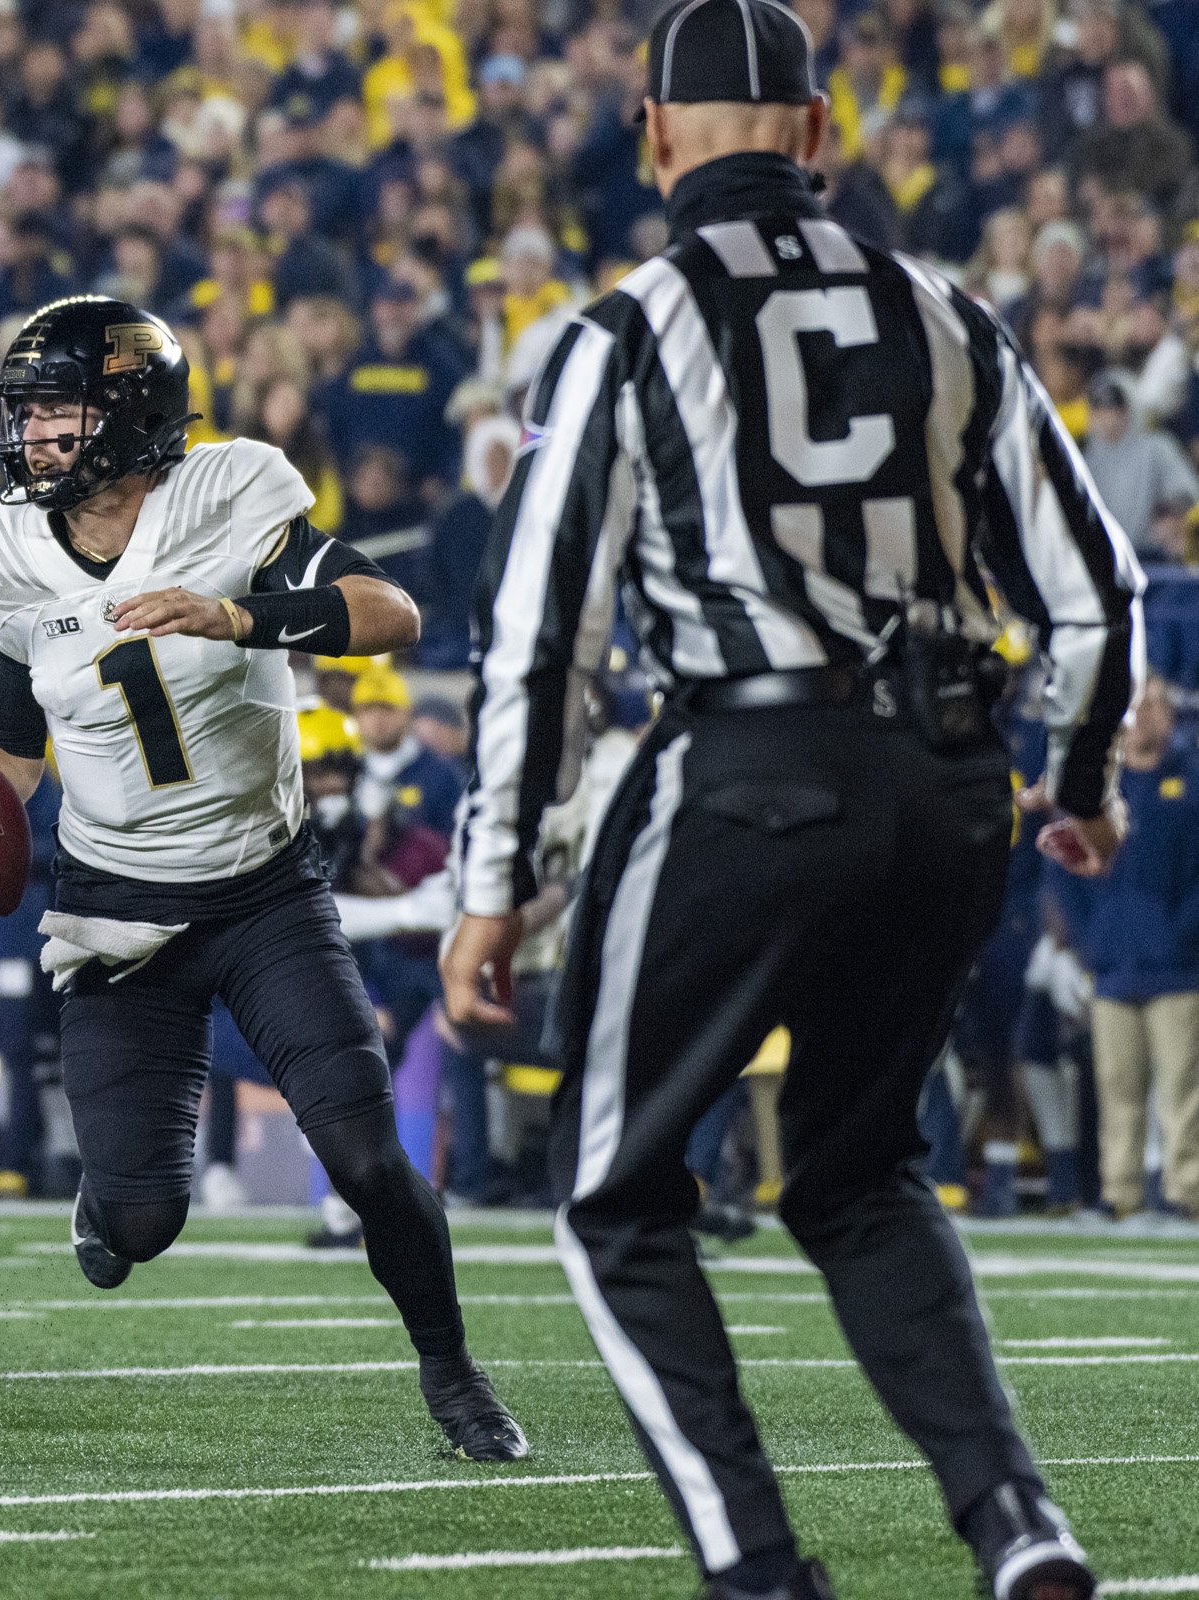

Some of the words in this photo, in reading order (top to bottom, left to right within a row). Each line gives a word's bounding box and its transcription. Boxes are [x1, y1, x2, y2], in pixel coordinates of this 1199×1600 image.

[103, 323, 163, 375] P
[755, 286, 896, 487] C
[94, 634, 194, 791] 1
